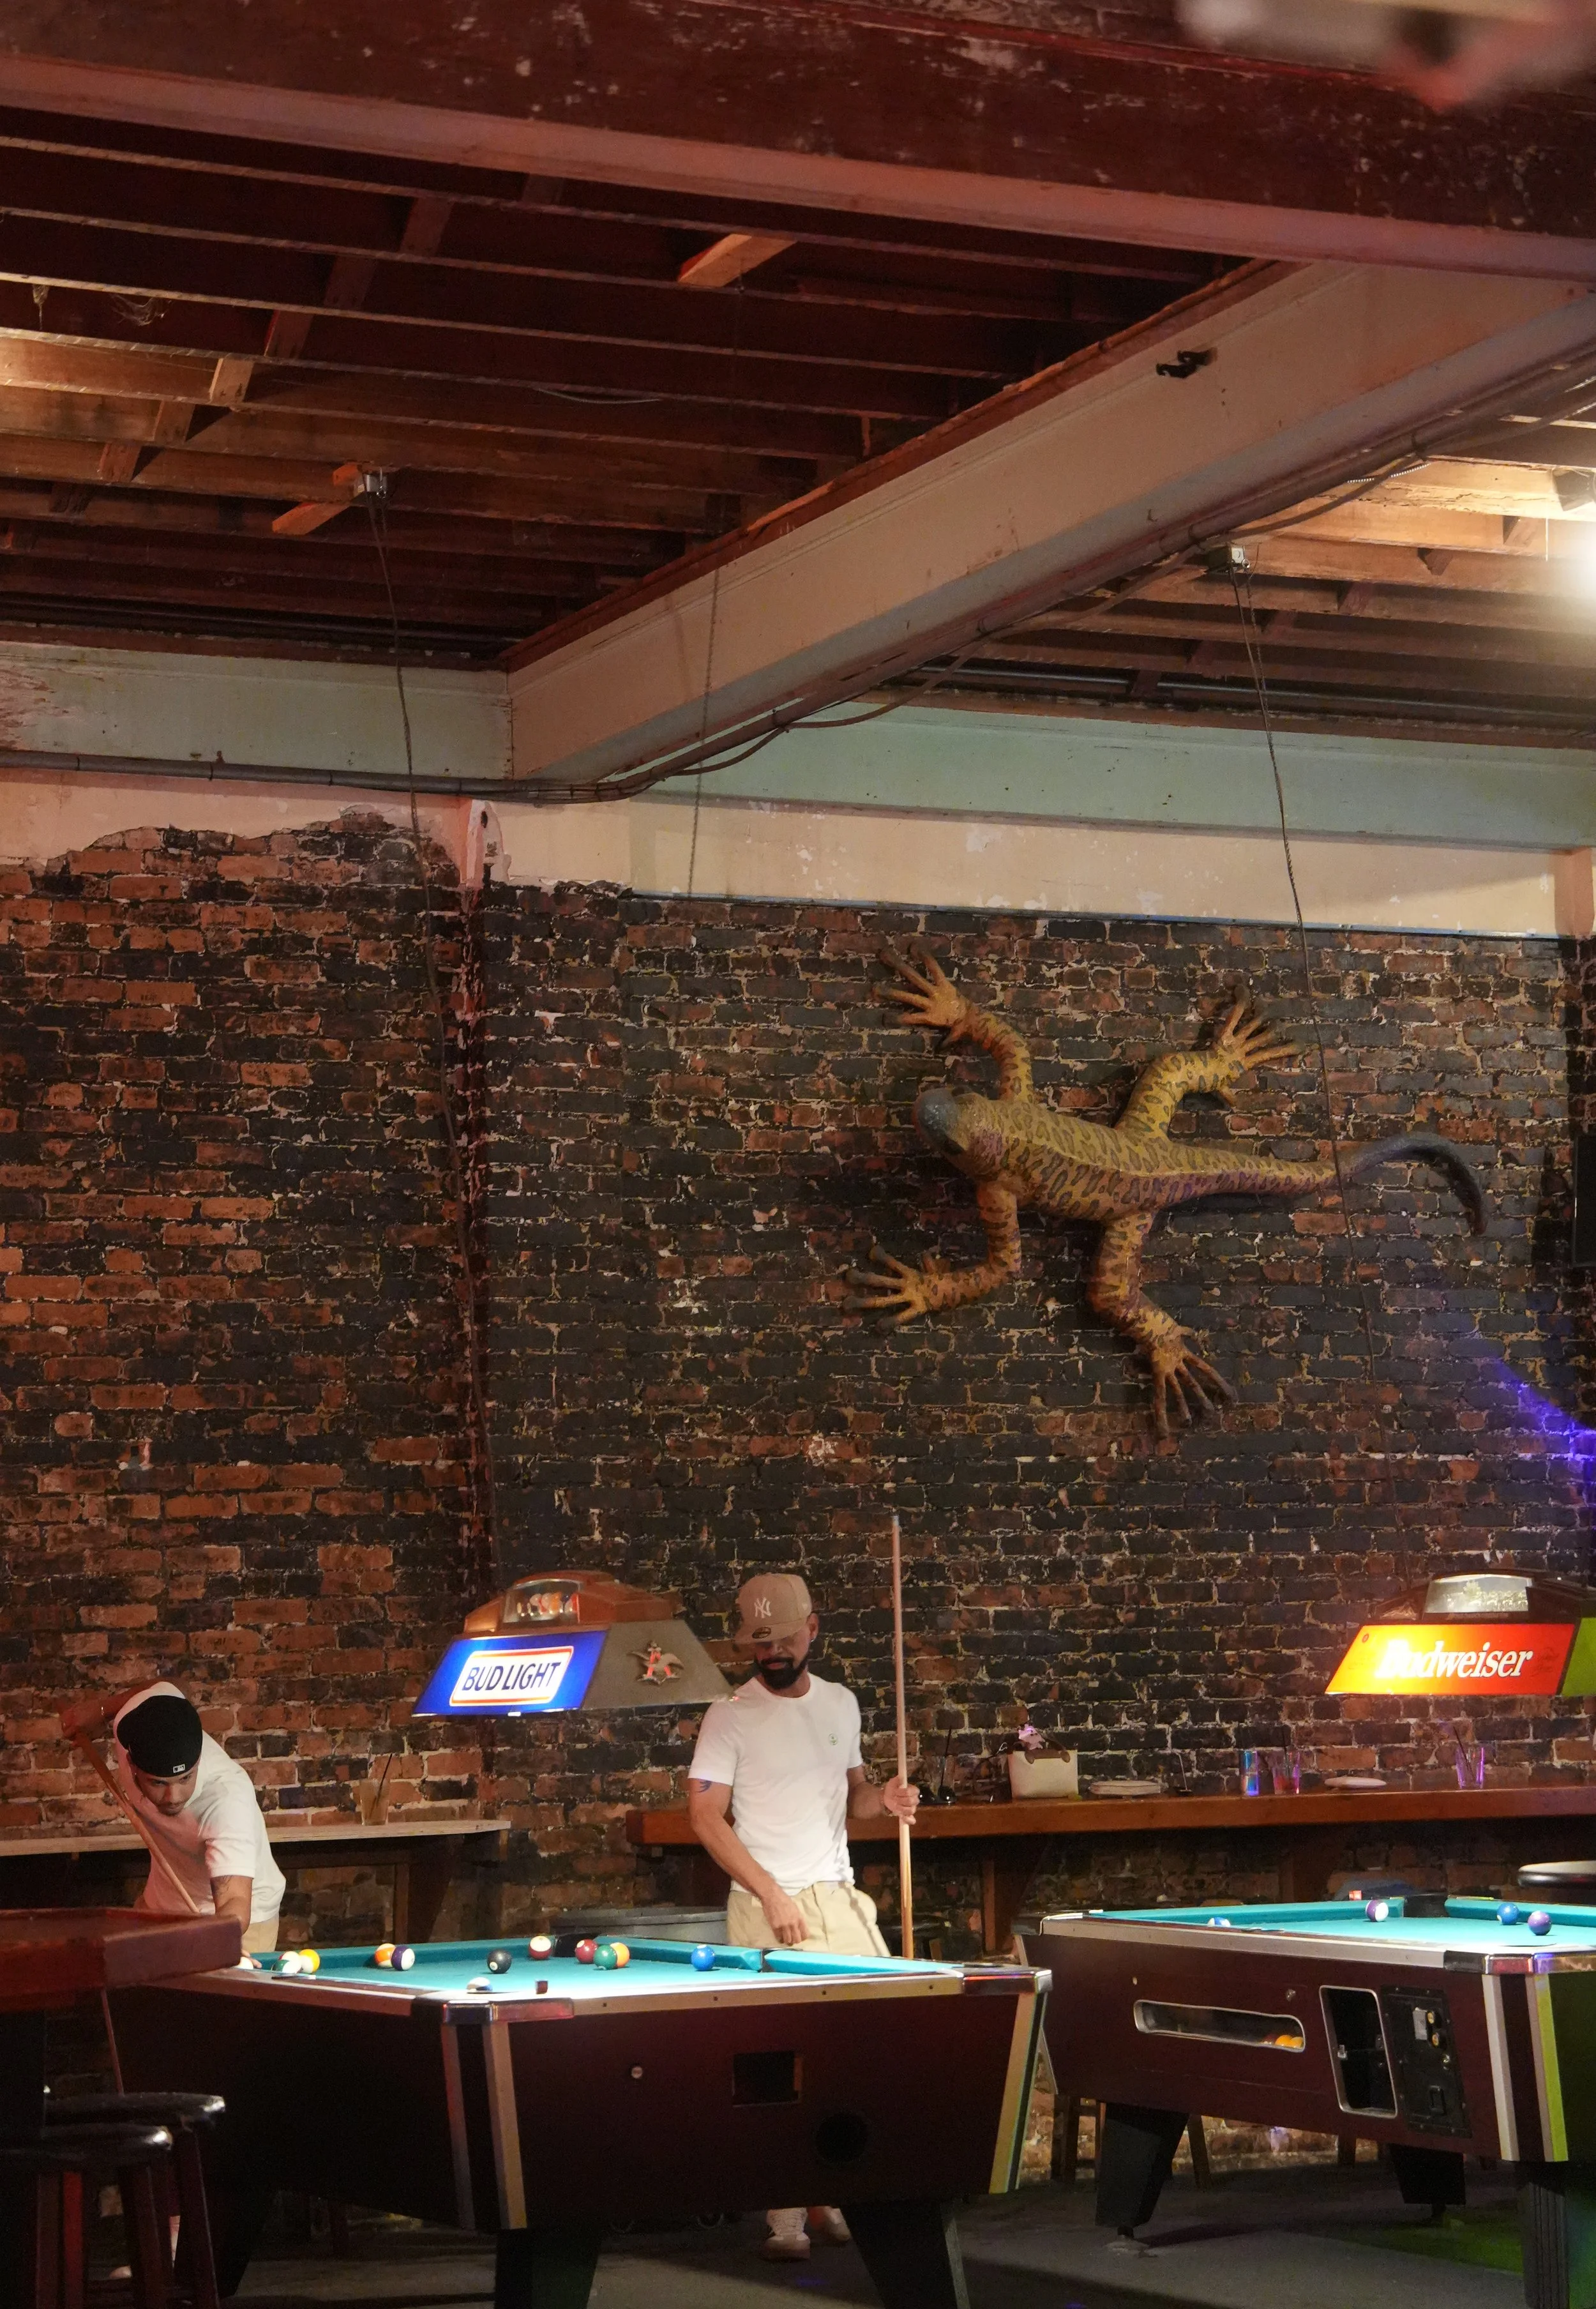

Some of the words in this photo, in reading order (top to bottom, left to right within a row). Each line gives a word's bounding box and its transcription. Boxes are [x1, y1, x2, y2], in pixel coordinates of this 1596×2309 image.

[753, 1597, 772, 1619] NY
[462, 1665, 504, 1692] BUD
[501, 1662, 562, 1691] LIGHT
